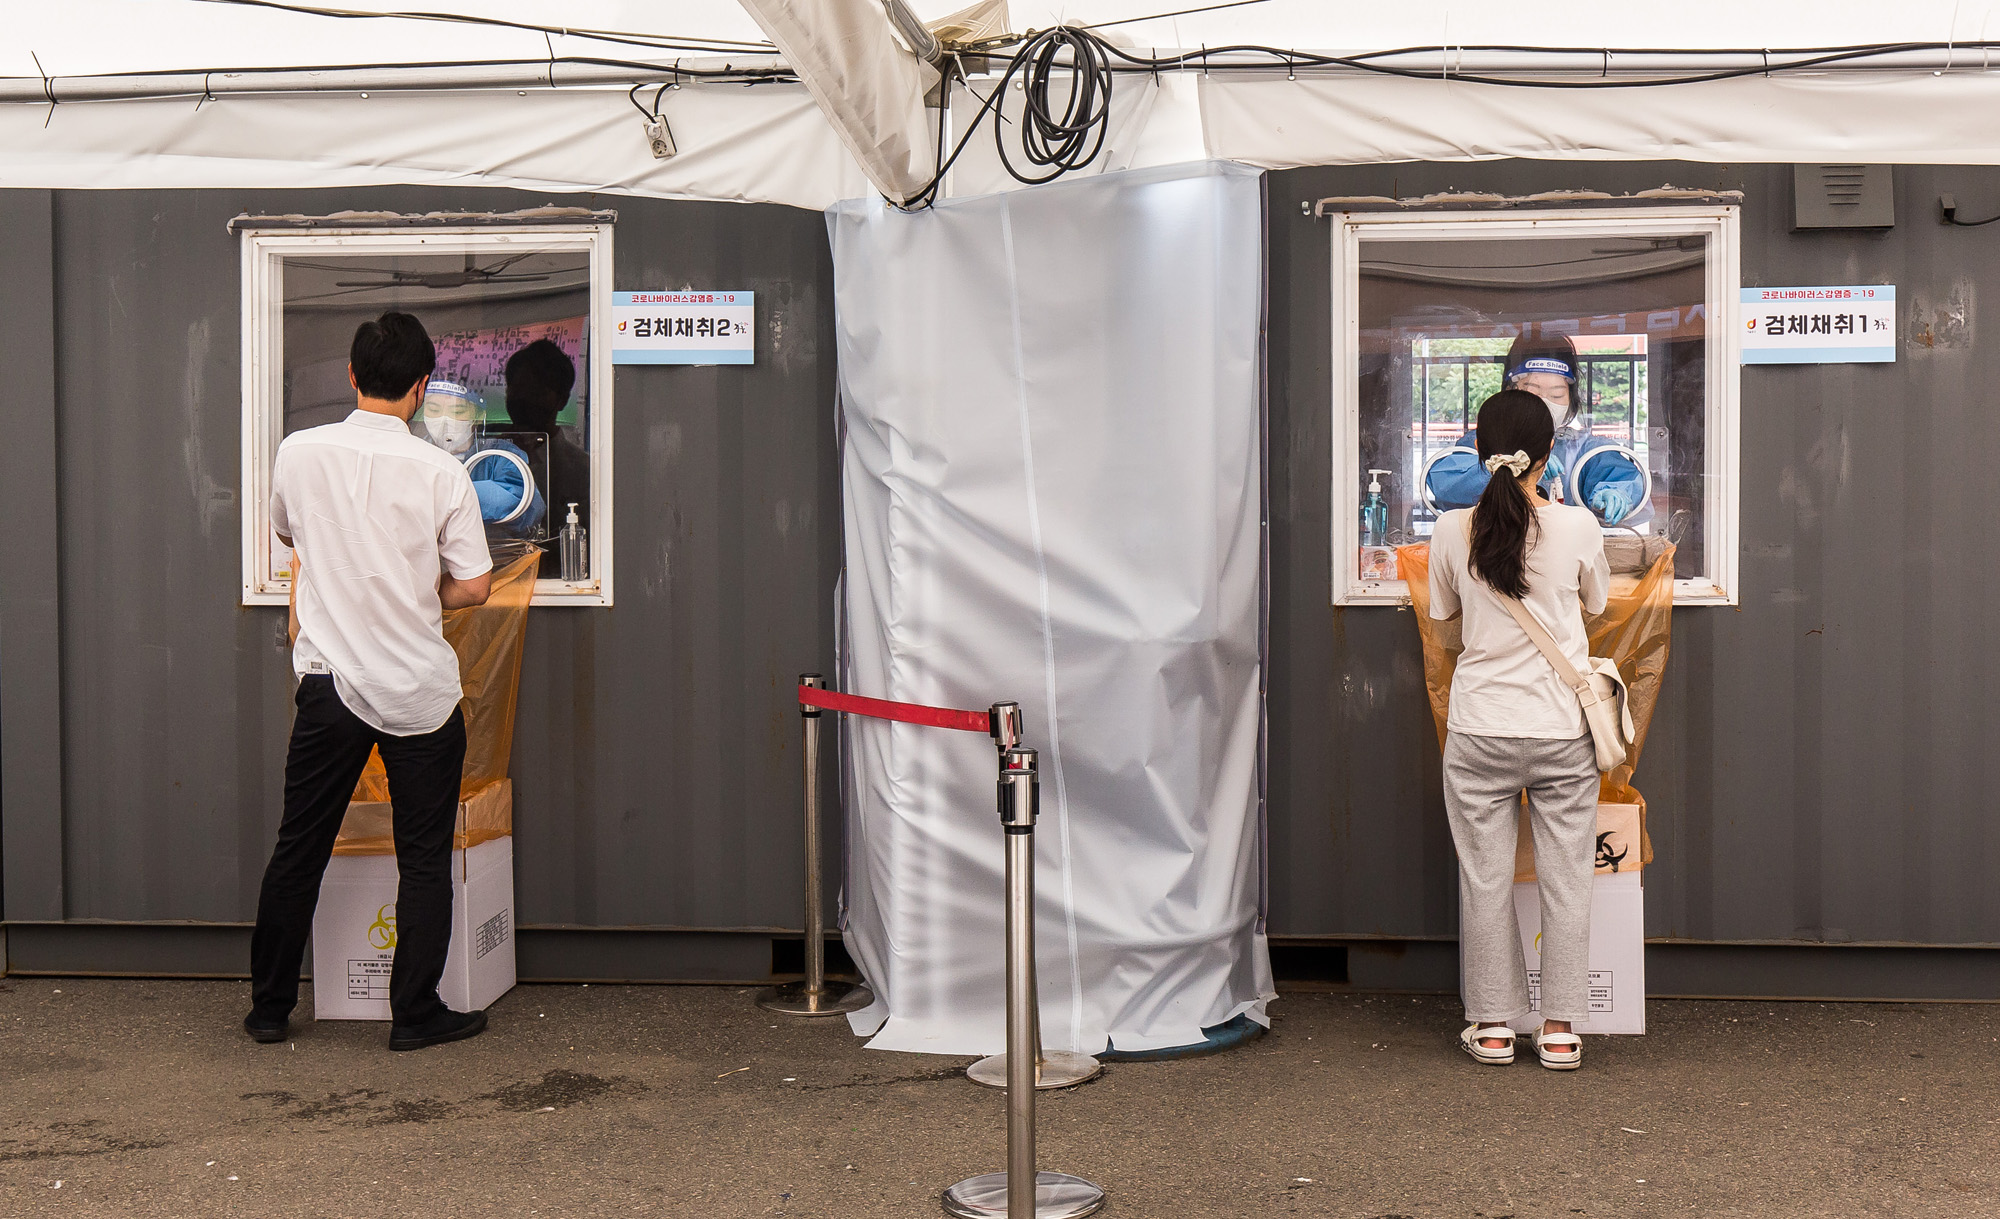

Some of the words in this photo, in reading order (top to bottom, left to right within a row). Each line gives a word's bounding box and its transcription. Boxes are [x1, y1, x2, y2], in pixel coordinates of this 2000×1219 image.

[631, 294, 714, 303] 코로나바이러스감염증
[722, 294, 735, 303] 19
[1761, 289, 1851, 299] 코로나바이러스감염증
[1861, 289, 1875, 298] 19
[633, 317, 731, 337] 검체채취2
[1765, 313, 1868, 336] 검체채취1
[1546, 362, 1567, 370] Shield
